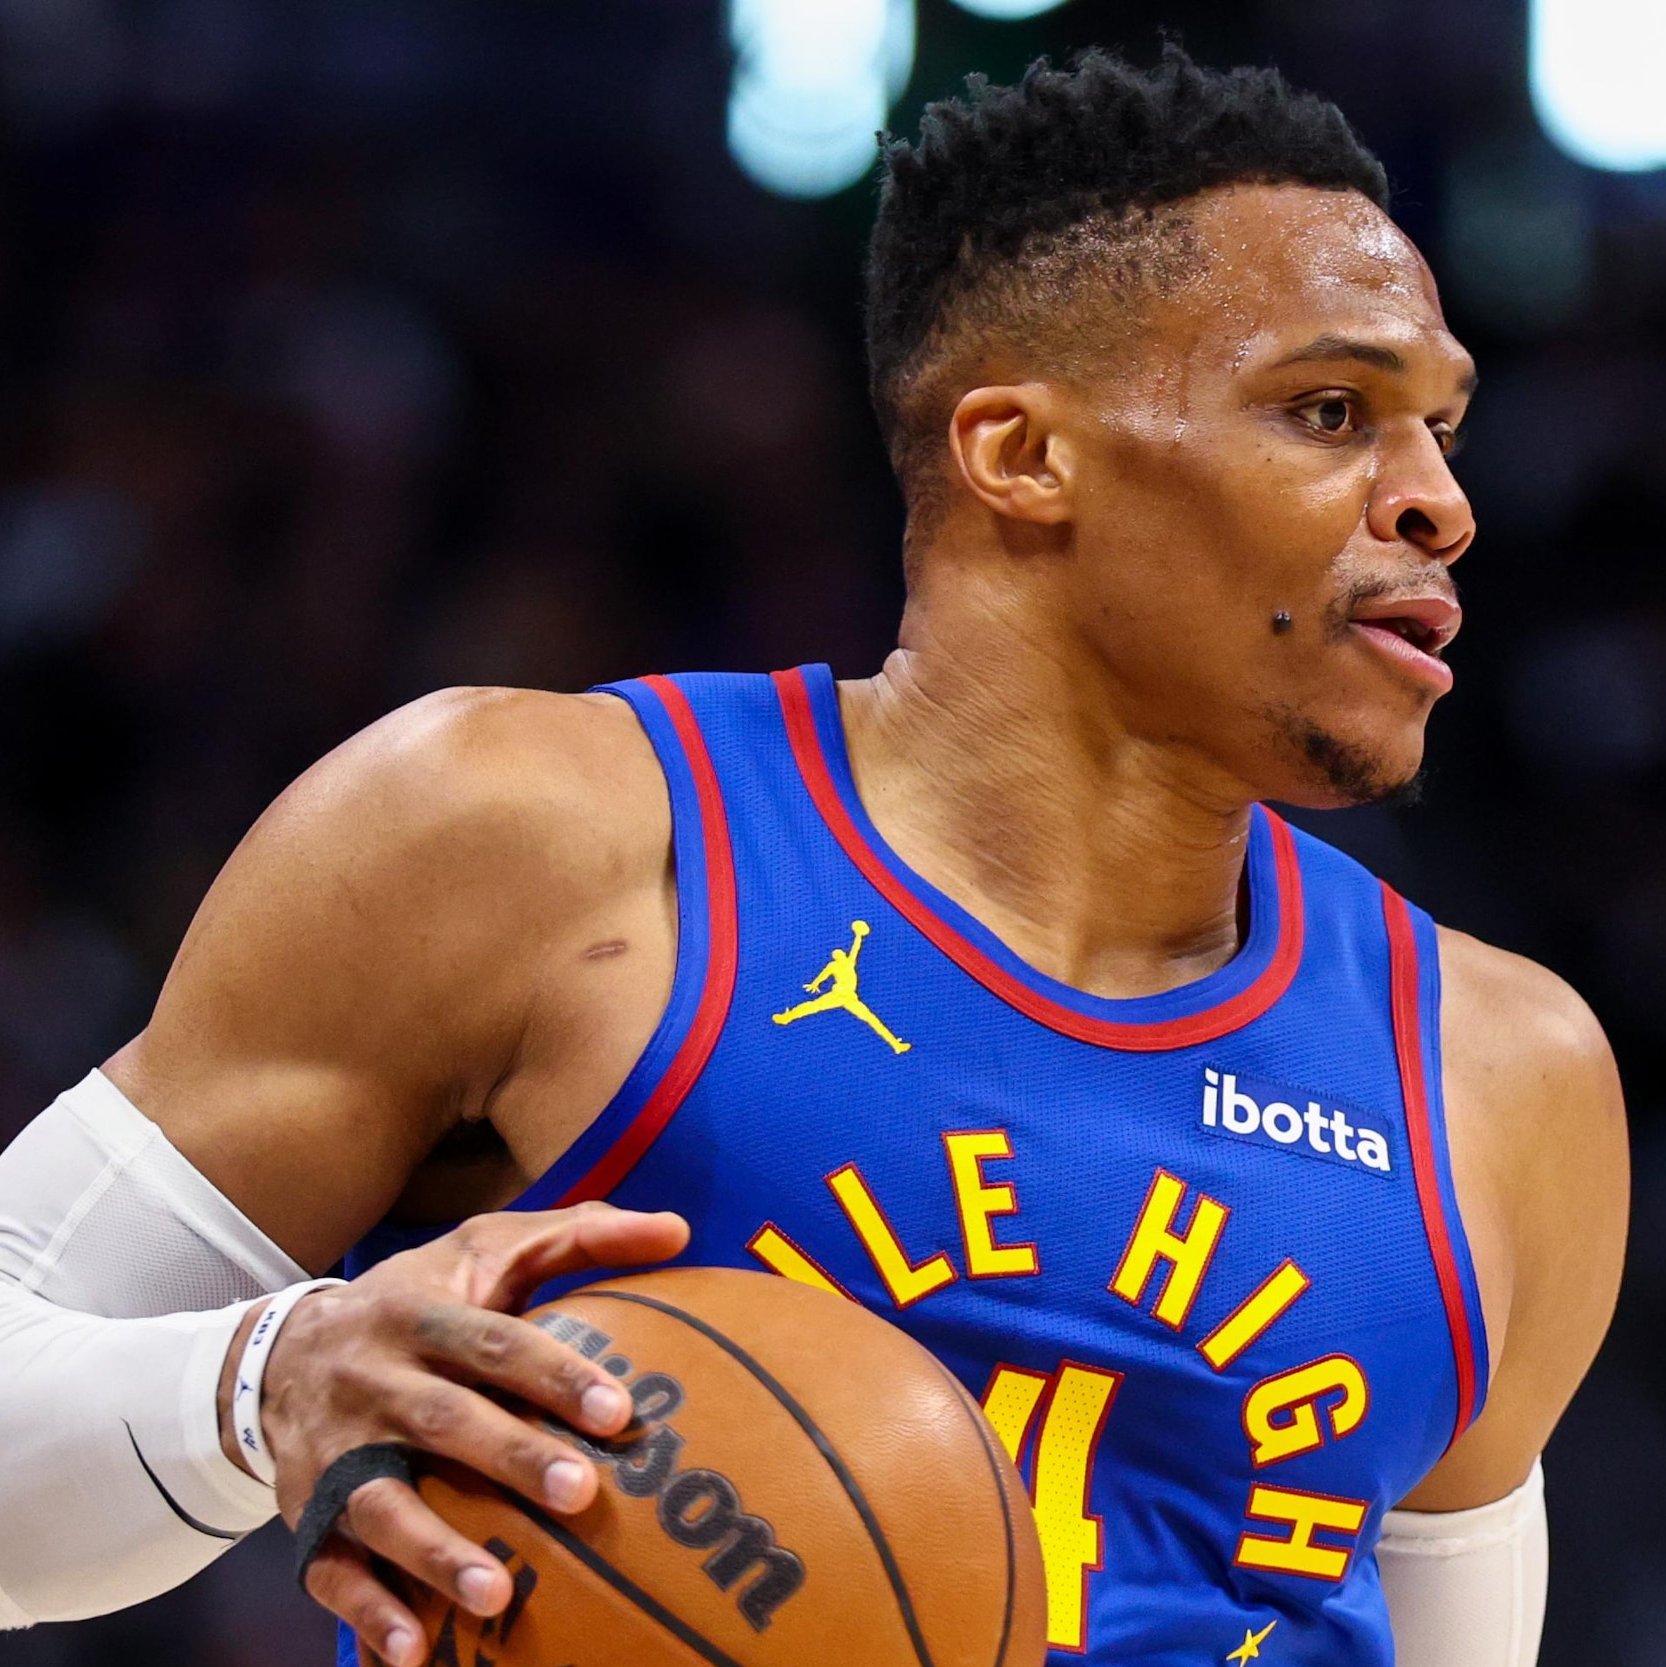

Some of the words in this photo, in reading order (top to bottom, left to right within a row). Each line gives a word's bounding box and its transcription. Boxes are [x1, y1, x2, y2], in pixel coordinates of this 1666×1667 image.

[1202, 1067, 1391, 1171] ibotta
[744, 1128, 1042, 1311] ILE
[1109, 1166, 1369, 1581] HIGH
[979, 1358, 1126, 1655] 4
